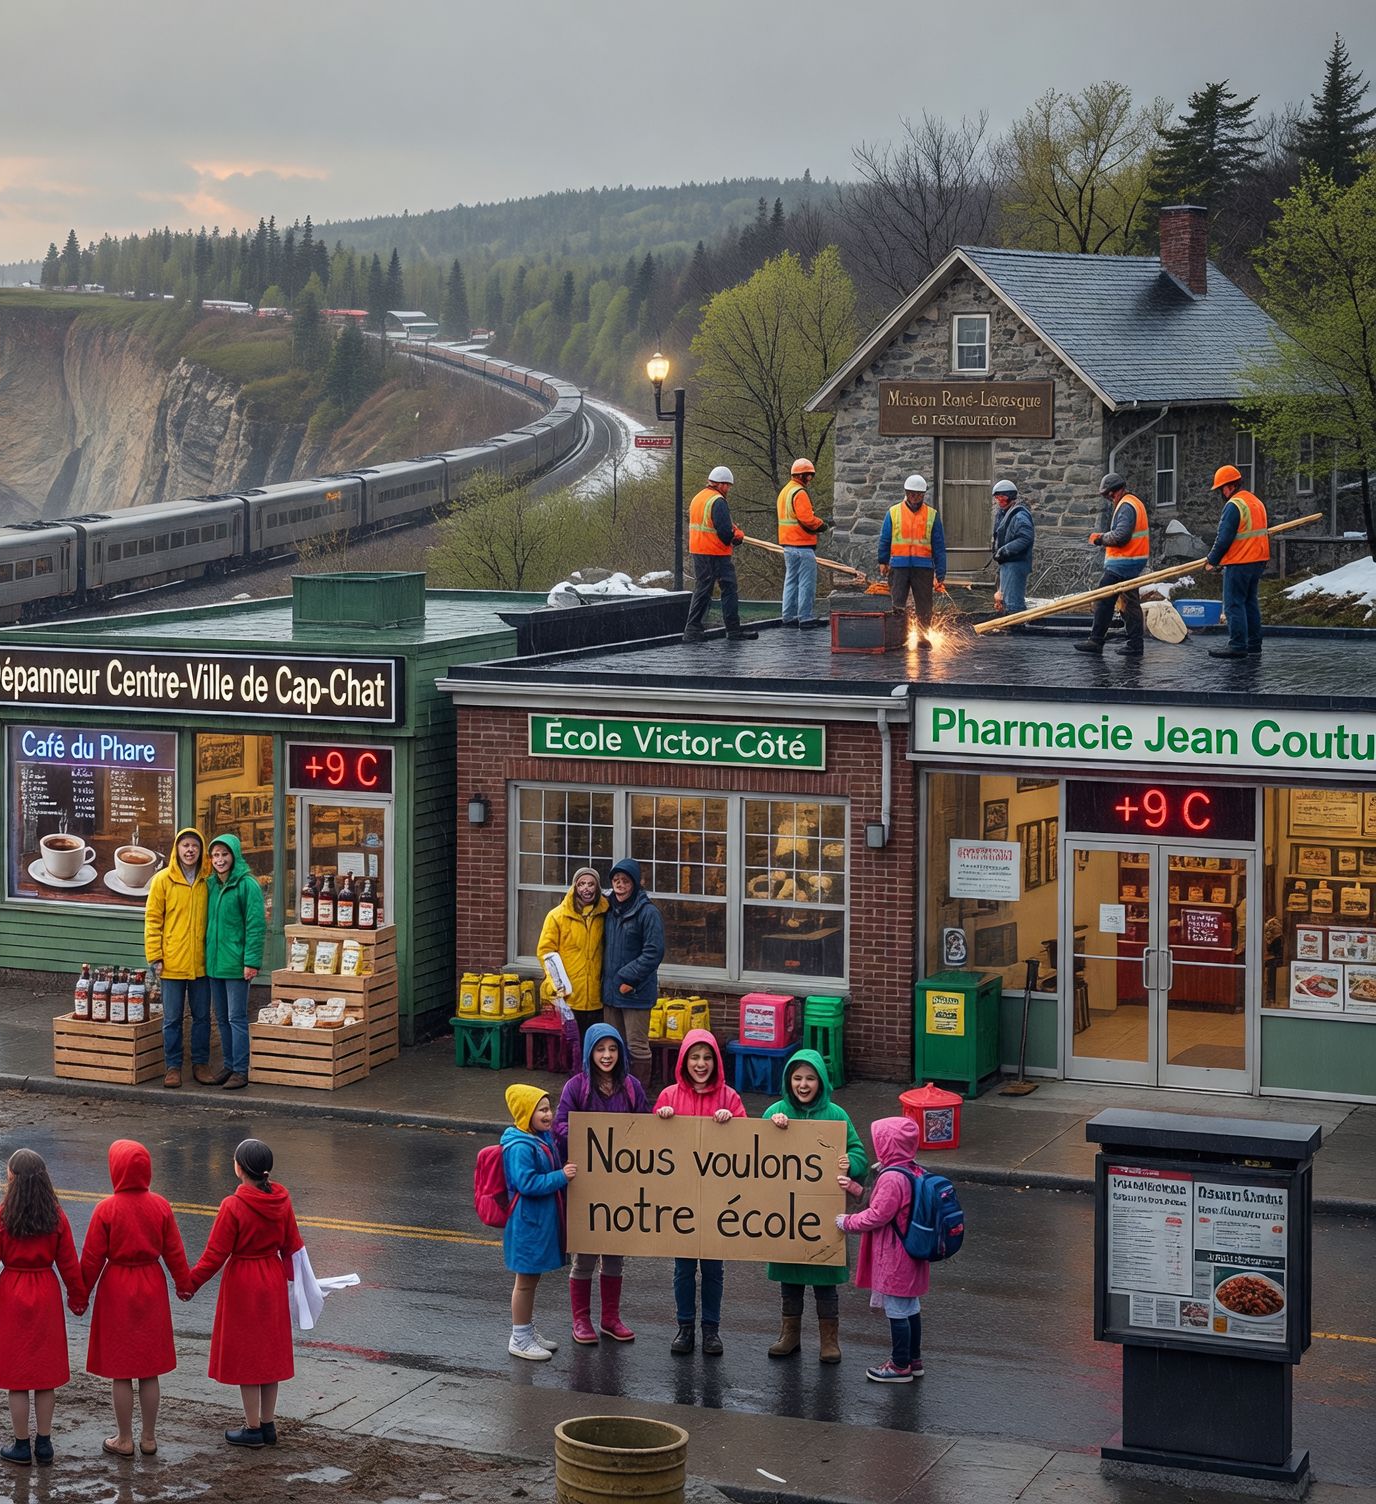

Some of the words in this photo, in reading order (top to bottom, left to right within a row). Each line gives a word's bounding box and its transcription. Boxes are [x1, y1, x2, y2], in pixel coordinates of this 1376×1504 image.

[911, 414, 928, 426] en
[106, 659, 234, 702] Centre-Ville
[240, 664, 269, 703] de
[275, 665, 385, 714] Cap-Chat
[21, 729, 66, 759] Café
[70, 733, 95, 761] du
[100, 734, 156, 763] Phare
[546, 716, 622, 751] École
[632, 726, 807, 760] Victor-Côté
[932, 707, 1133, 751] Pharmacie
[1143, 715, 1239, 756] Jean
[305, 751, 346, 785] +9
[355, 751, 378, 787] C
[1114, 789, 1168, 829] +9
[1181, 791, 1211, 831] C
[586, 1126, 676, 1176] Nous
[692, 1133, 824, 1183] voulons
[588, 1187, 696, 1236] notre
[716, 1191, 823, 1242] école
